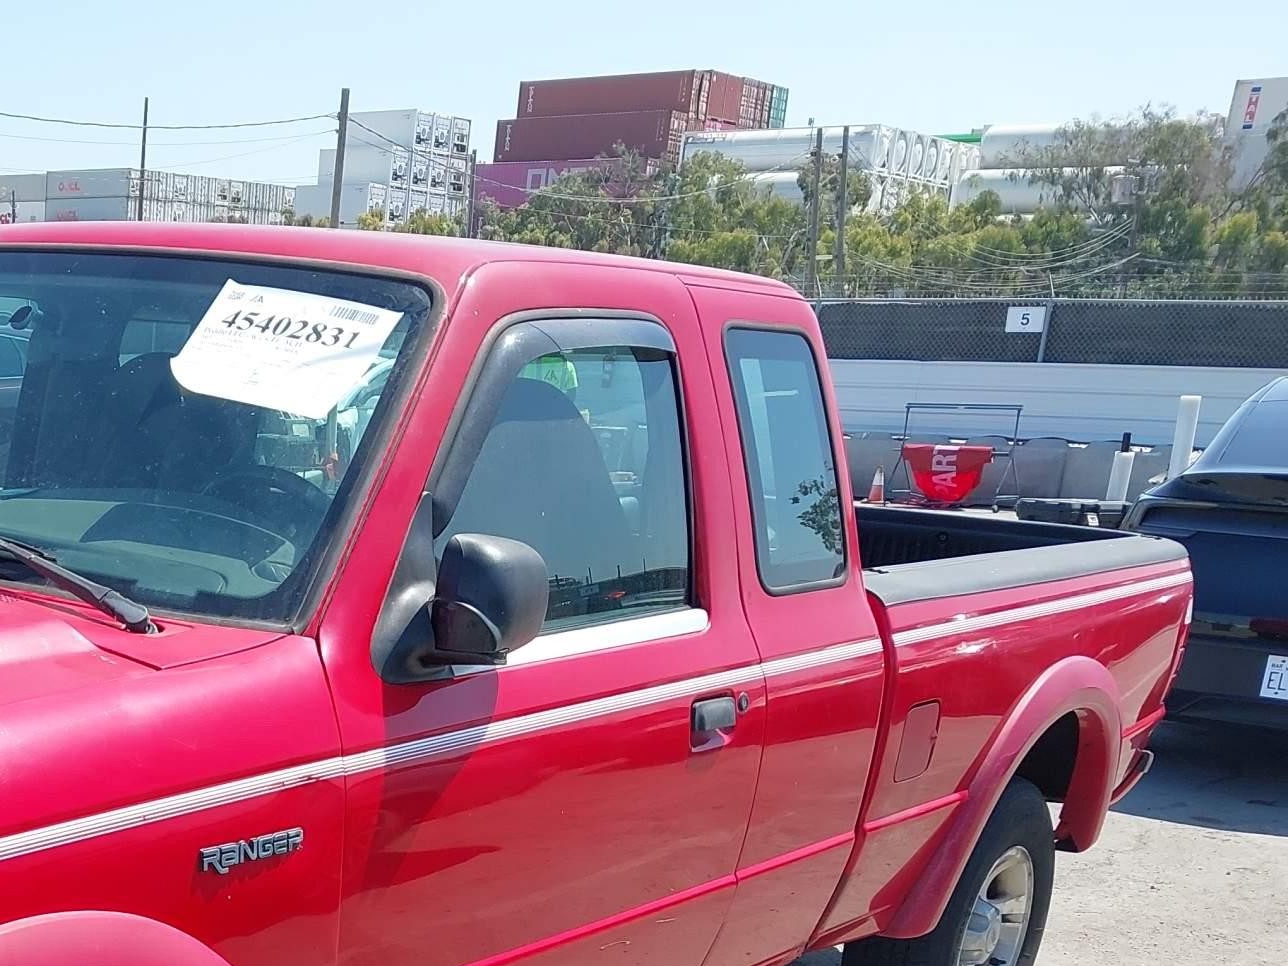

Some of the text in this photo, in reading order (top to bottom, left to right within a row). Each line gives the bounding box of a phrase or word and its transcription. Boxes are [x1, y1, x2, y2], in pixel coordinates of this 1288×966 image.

[222, 310, 360, 349] 45402831
[1020, 313, 1030, 326] 5
[200, 827, 304, 875] RANGER
